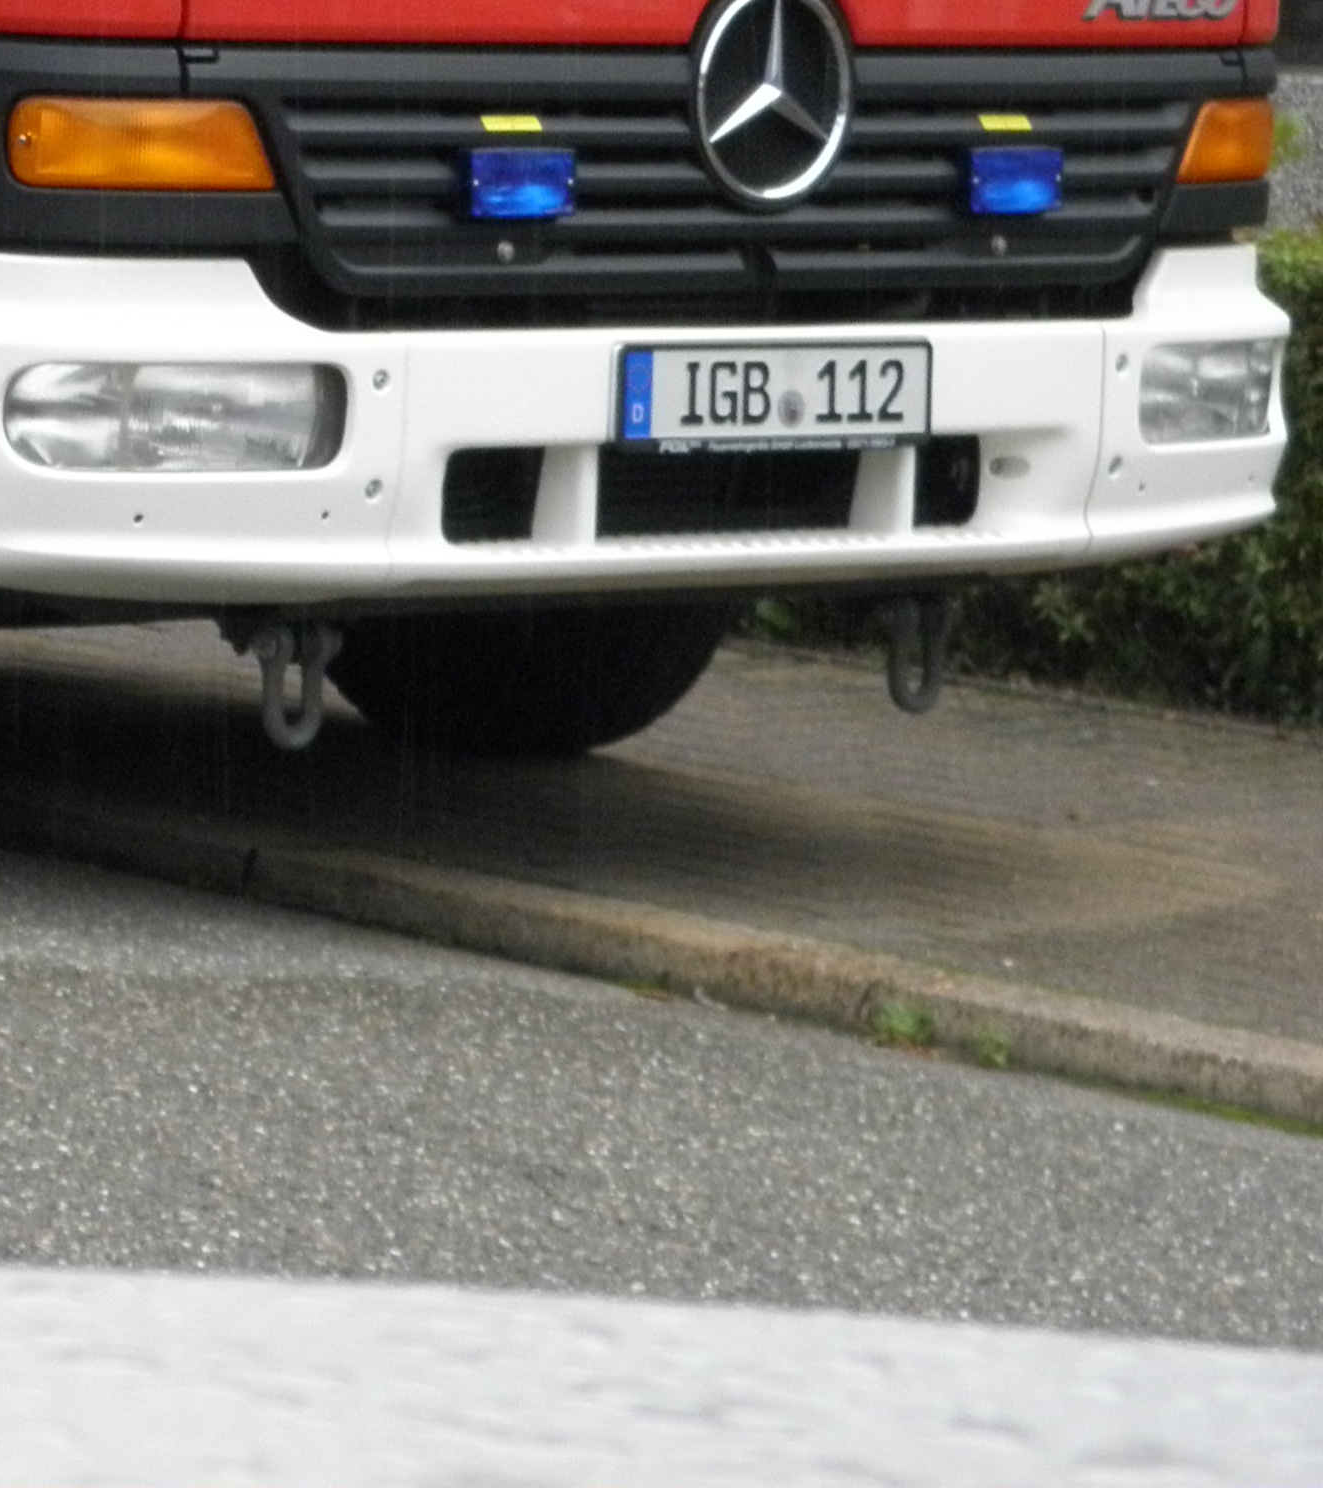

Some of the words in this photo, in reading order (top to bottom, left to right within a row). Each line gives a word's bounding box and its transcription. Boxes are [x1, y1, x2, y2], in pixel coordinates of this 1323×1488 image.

[631, 404, 644, 424] D
[680, 360, 771, 426] IGB
[815, 359, 904, 424] 112
